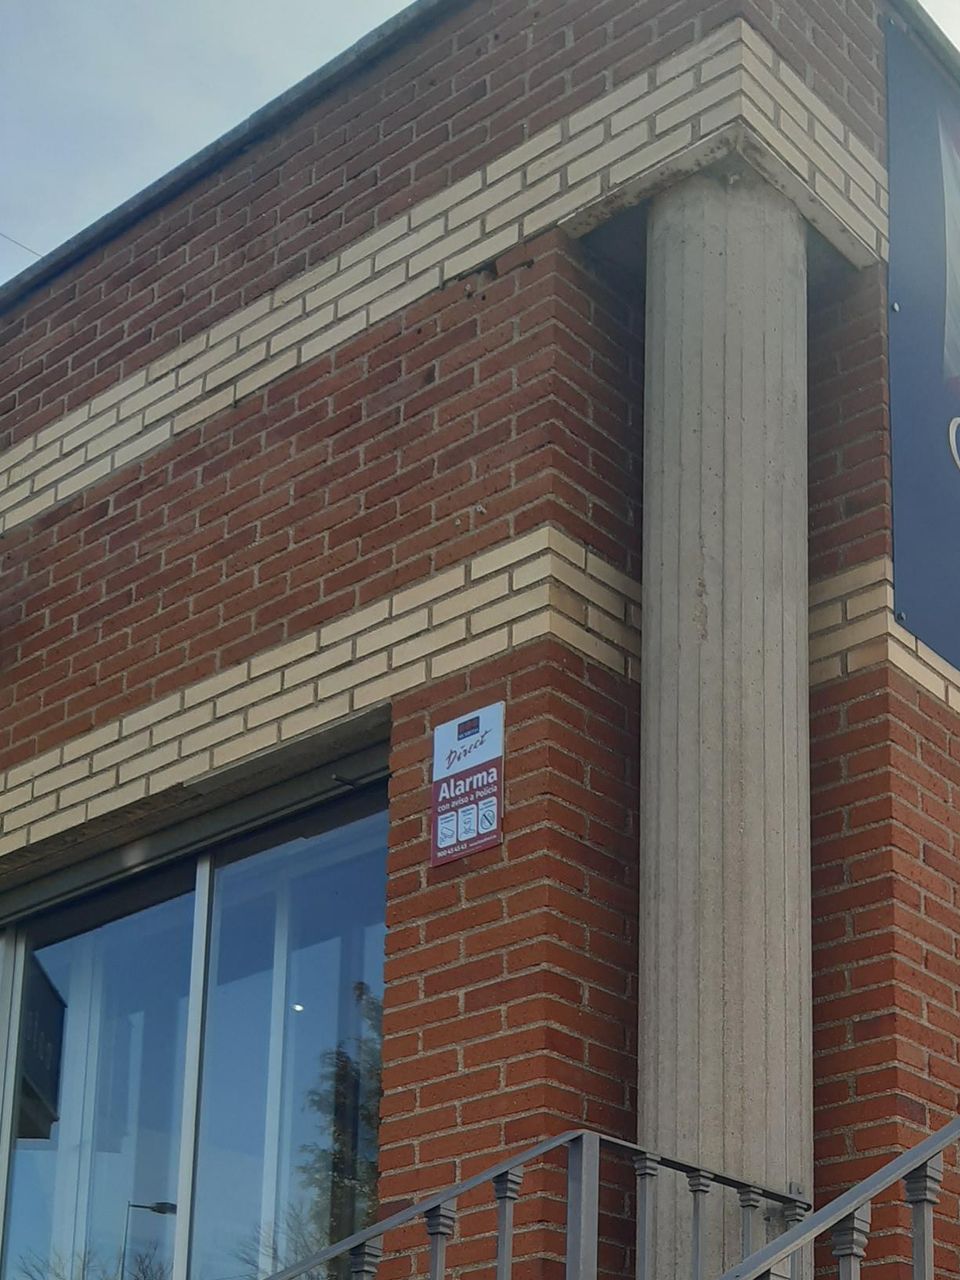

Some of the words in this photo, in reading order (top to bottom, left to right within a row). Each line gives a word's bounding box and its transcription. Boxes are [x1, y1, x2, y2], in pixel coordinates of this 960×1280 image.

[438, 767, 498, 802] Alarma
[438, 804, 450, 813] con
[451, 797, 469, 808] aviso
